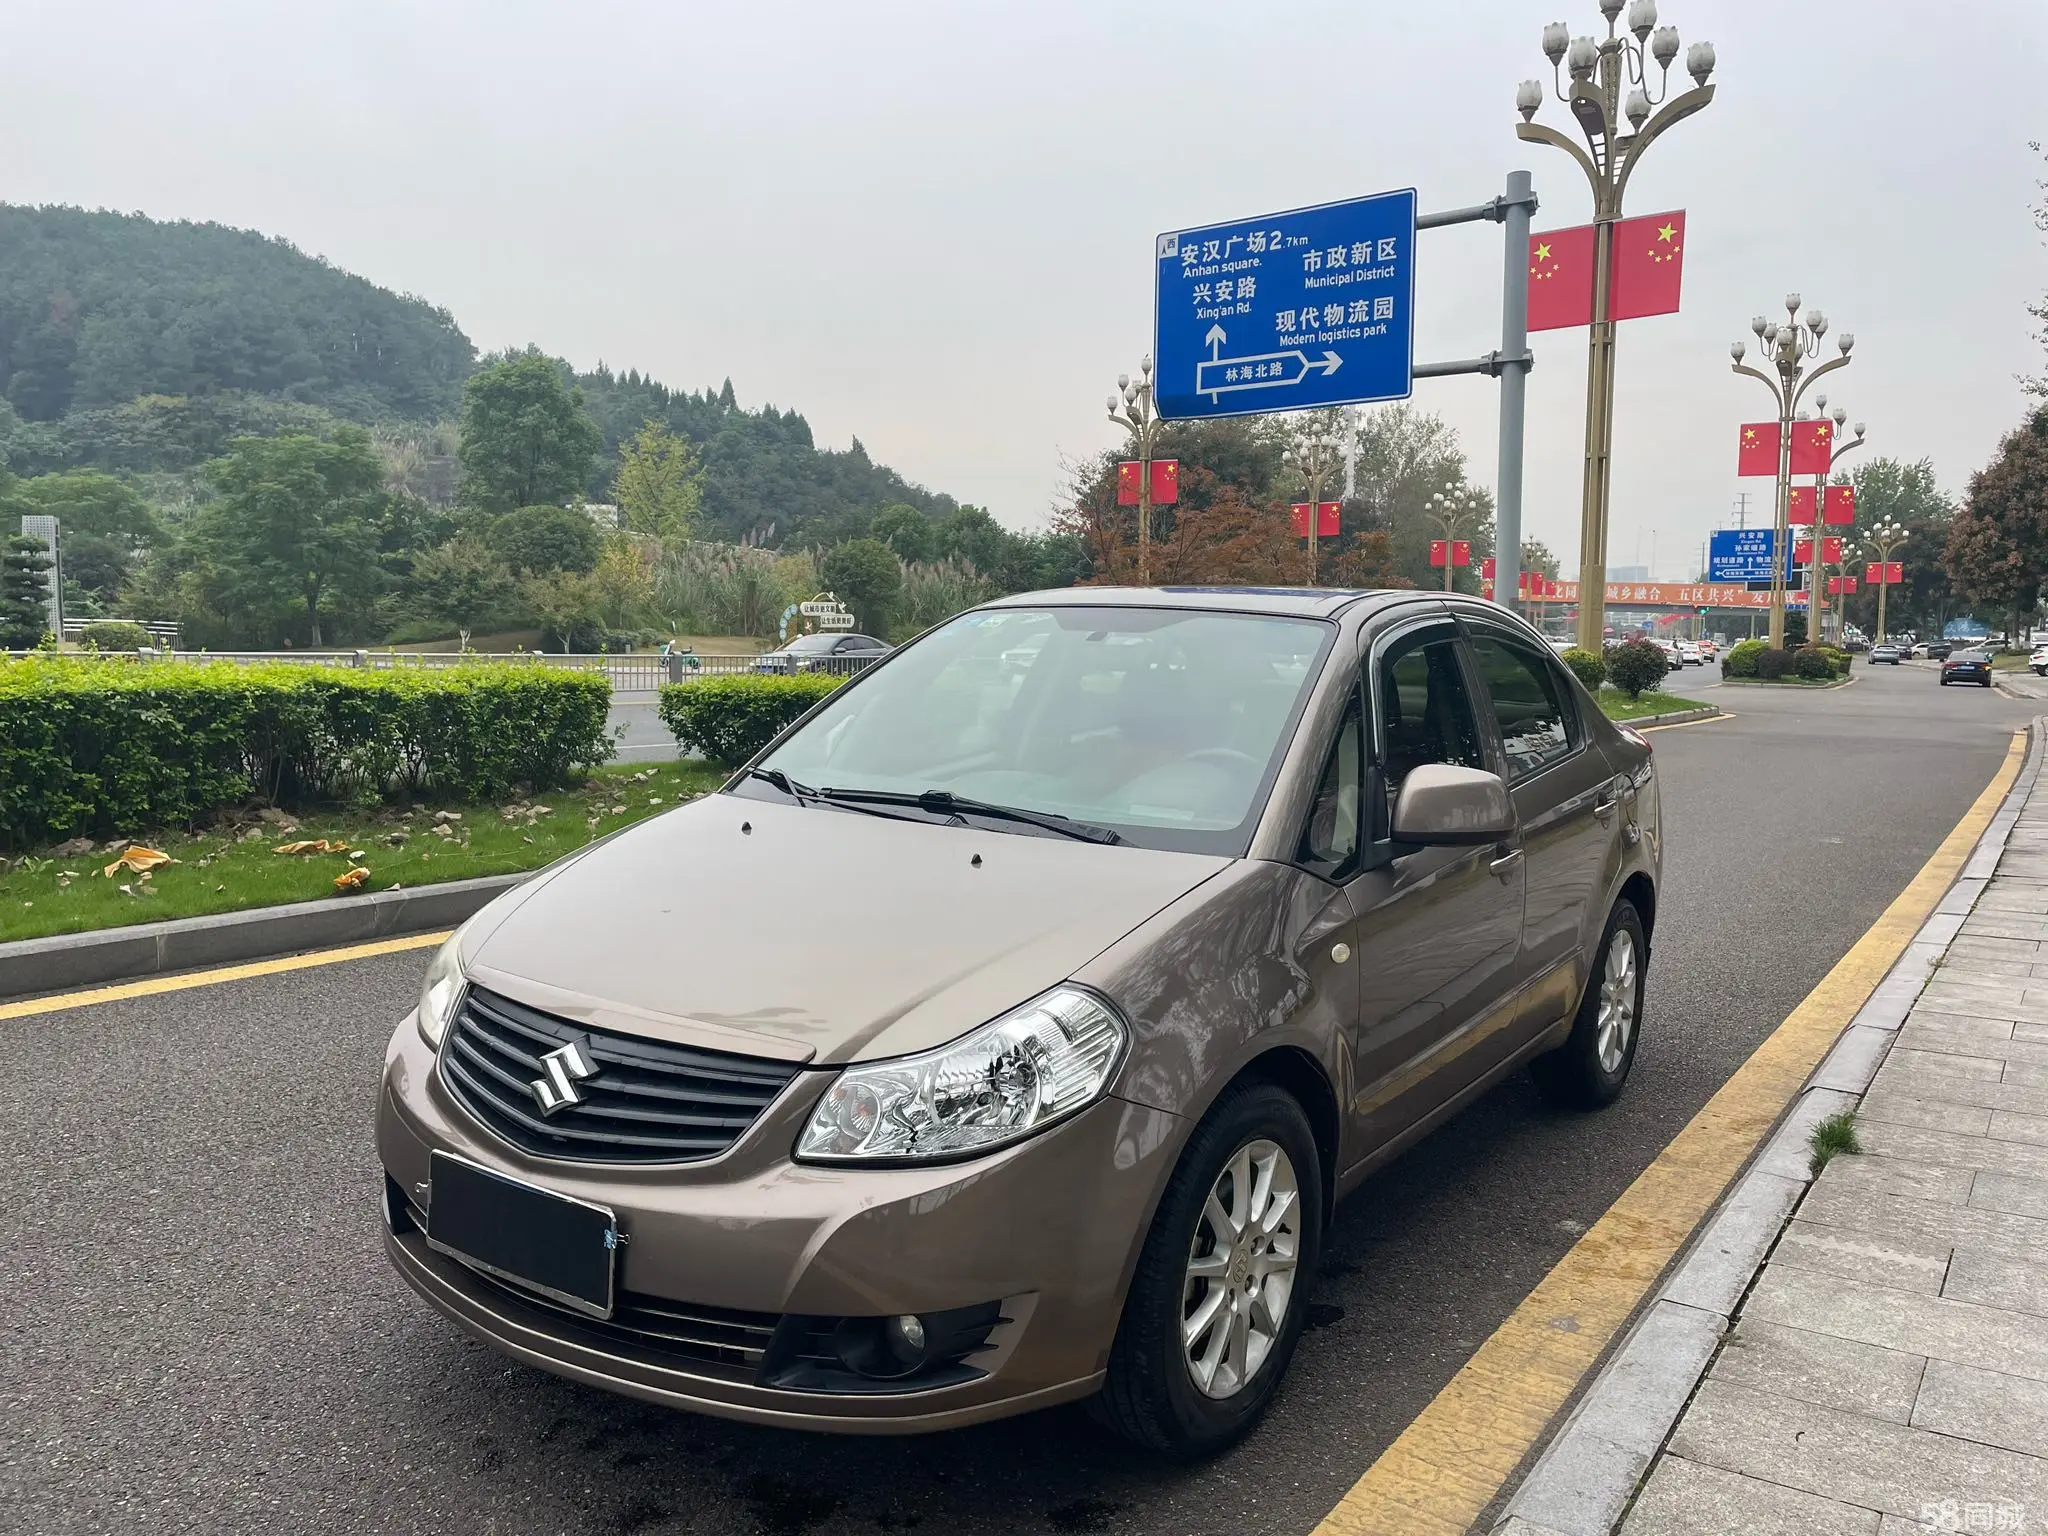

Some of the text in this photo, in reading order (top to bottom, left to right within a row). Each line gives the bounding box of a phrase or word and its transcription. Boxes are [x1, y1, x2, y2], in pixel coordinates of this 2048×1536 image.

[1302, 237, 1397, 273] 市政新区
[1183, 265, 1219, 279] Anhan
[1304, 265, 1395, 289] Municipal District
[1193, 276, 1257, 305] 兴安路
[1196, 305, 1234, 320] Xing'an
[1275, 296, 1394, 333] 现代物流园
[1279, 323, 1387, 346] Modern logistics park
[1225, 361, 1283, 382] 林海北路
